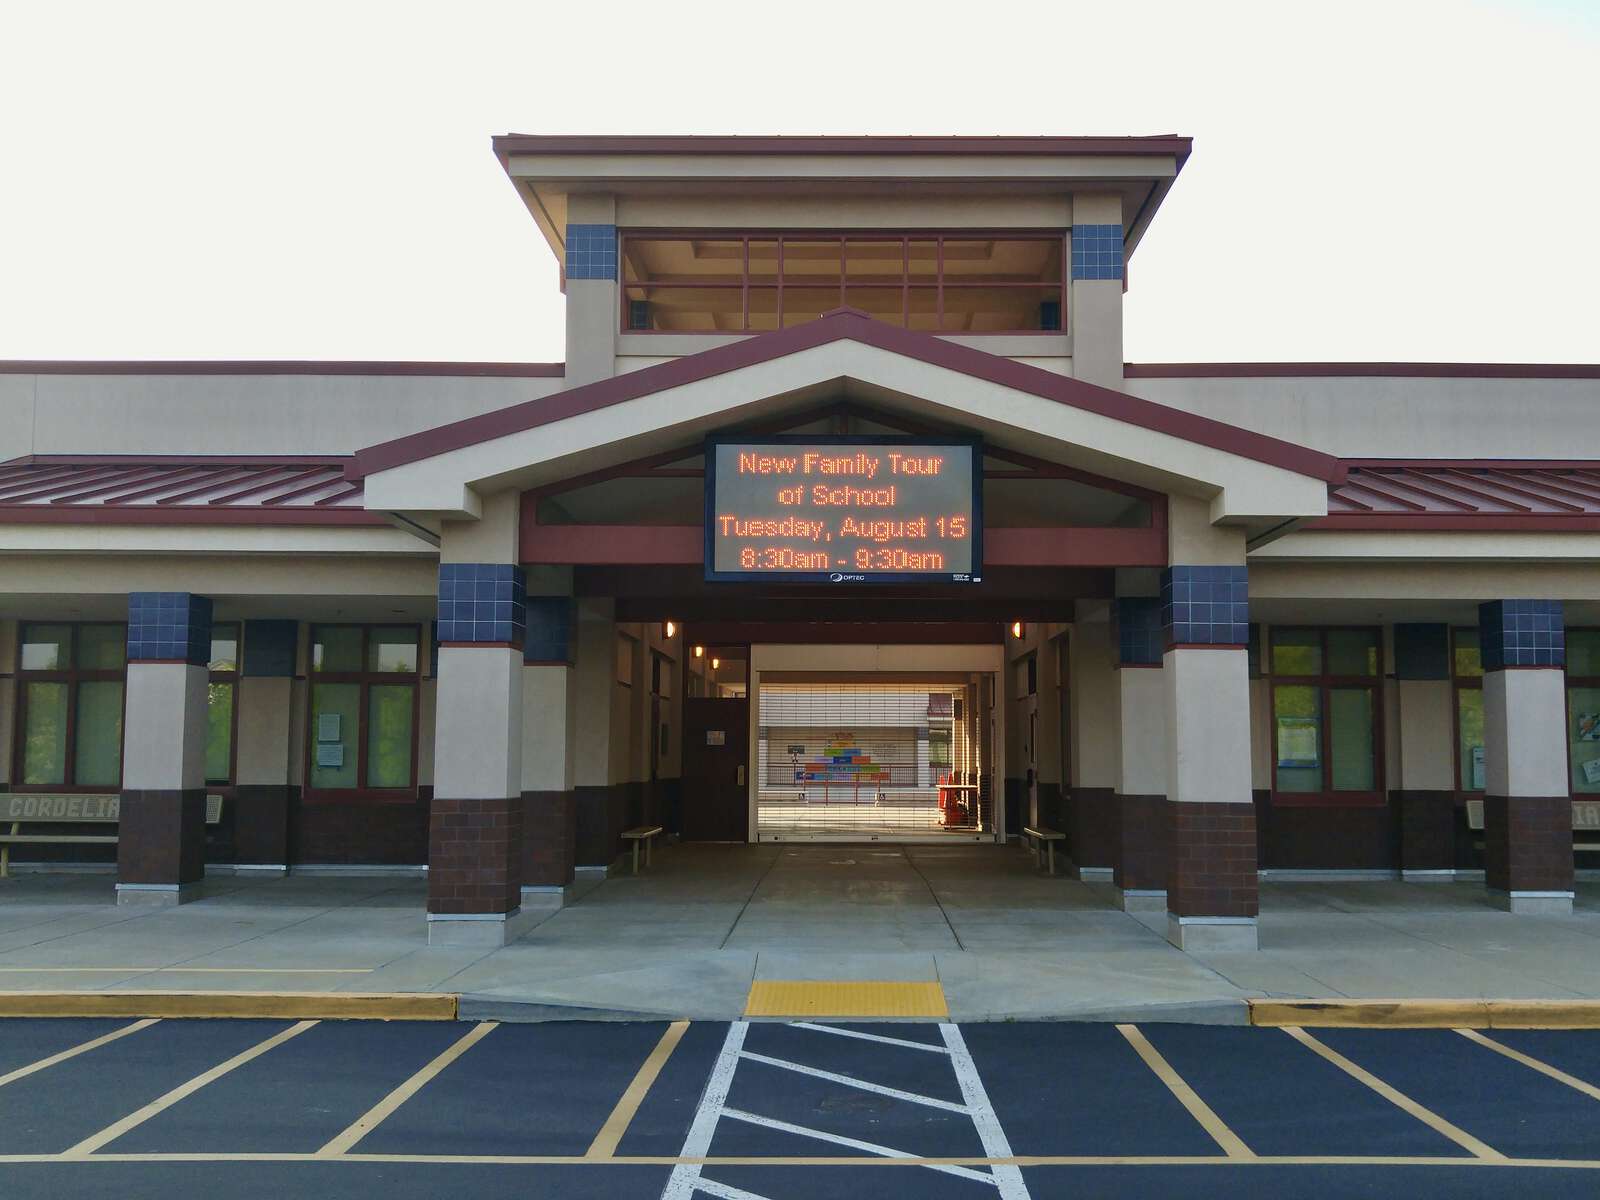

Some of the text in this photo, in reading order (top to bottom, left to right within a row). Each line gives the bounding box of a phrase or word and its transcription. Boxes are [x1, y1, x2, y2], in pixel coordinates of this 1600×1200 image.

[739, 452, 942, 480] New Family Tour
[778, 484, 896, 507] of School
[720, 514, 968, 544] Tuesday, August 15
[741, 547, 829, 569] 8:30am
[855, 547, 944, 570] 9:30am
